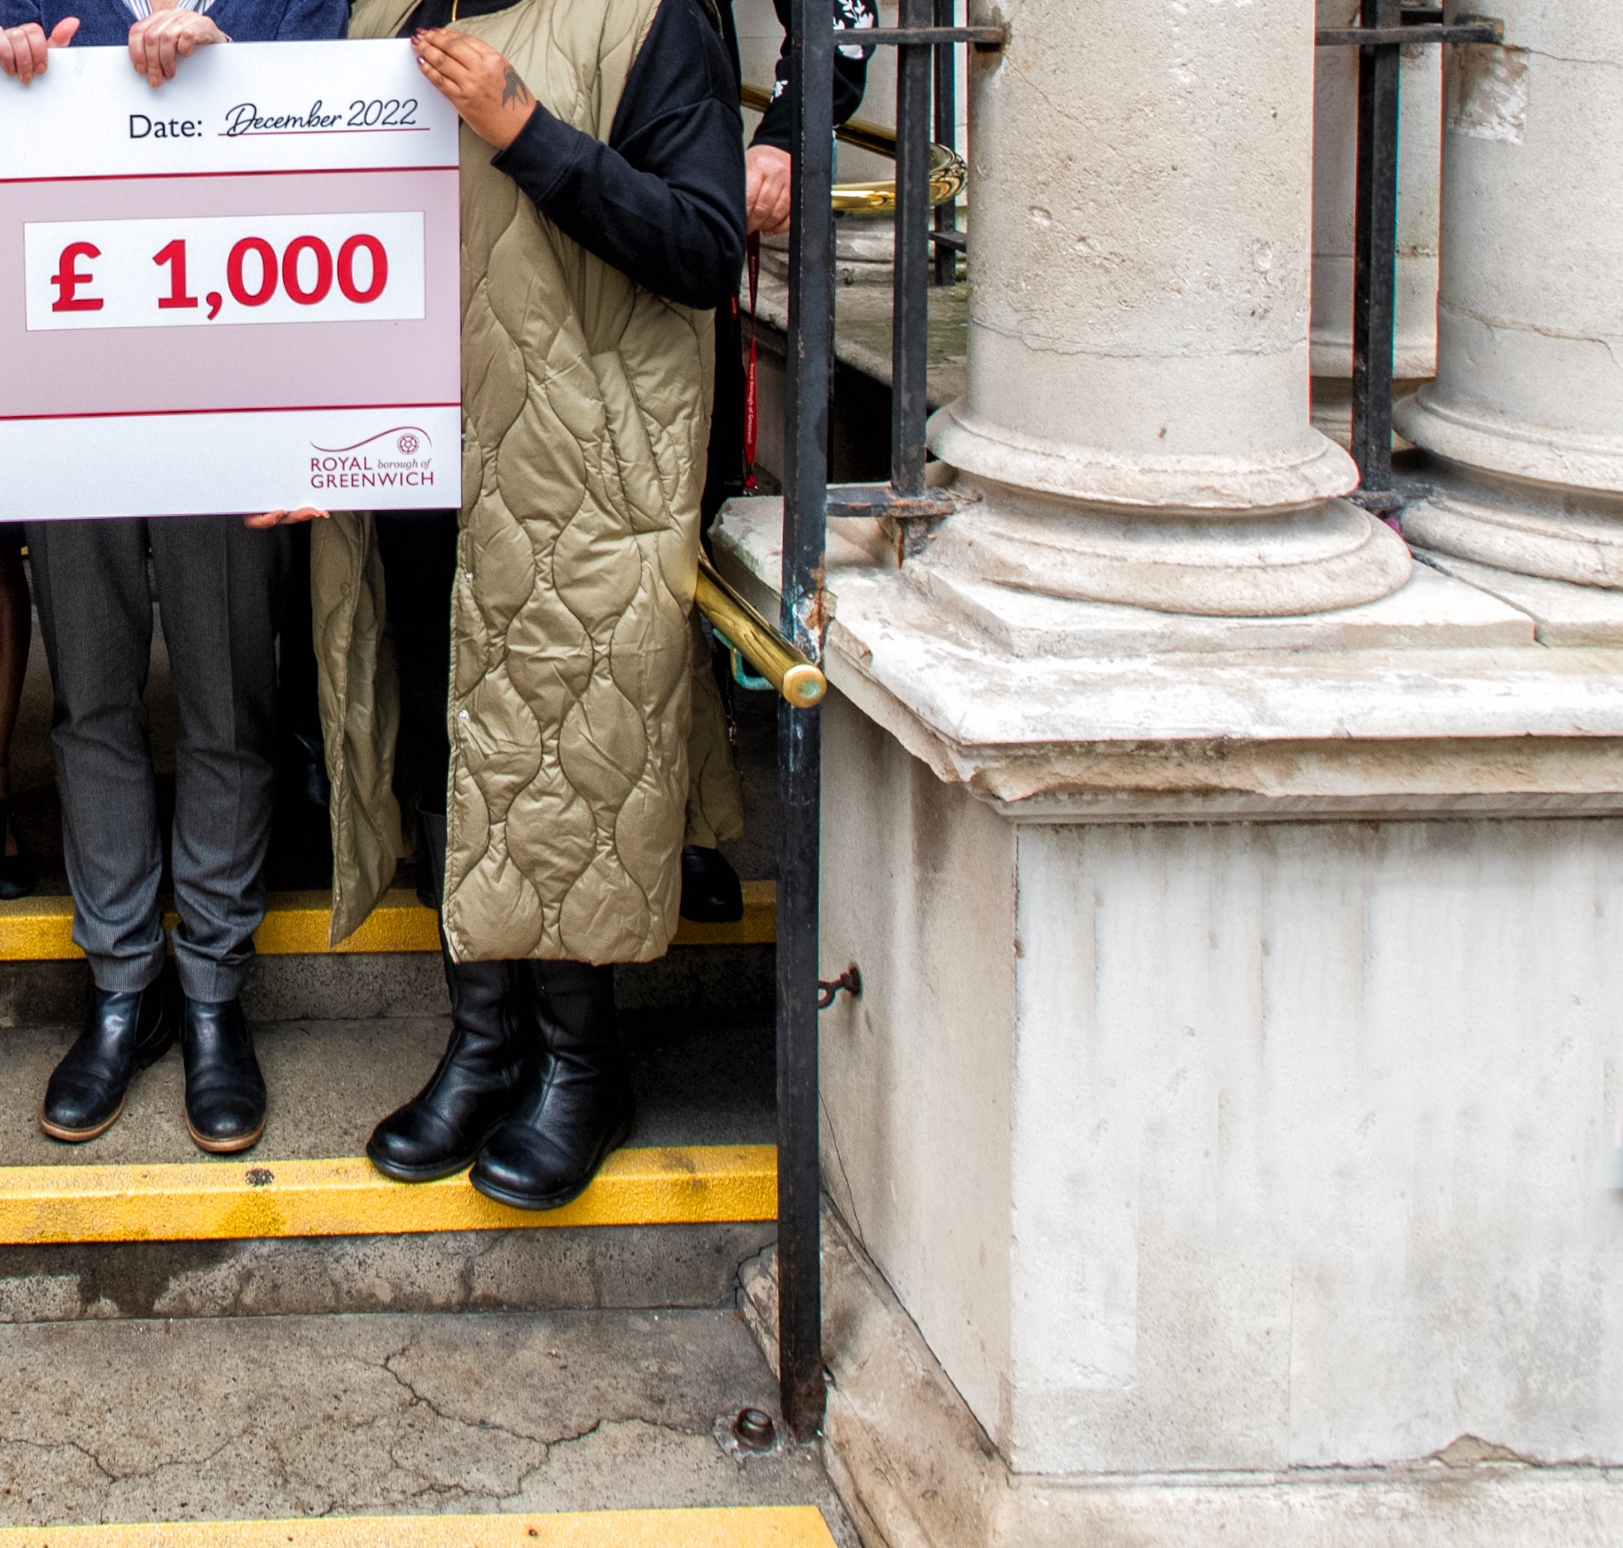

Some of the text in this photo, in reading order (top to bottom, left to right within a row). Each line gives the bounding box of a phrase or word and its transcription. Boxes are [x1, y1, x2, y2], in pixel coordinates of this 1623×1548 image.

[128, 98, 418, 139] Date: December 2022
[50, 233, 389, 322] £ 1,000
[310, 456, 433, 472] ROYAL borough of
[310, 471, 435, 489] GREENWICH
